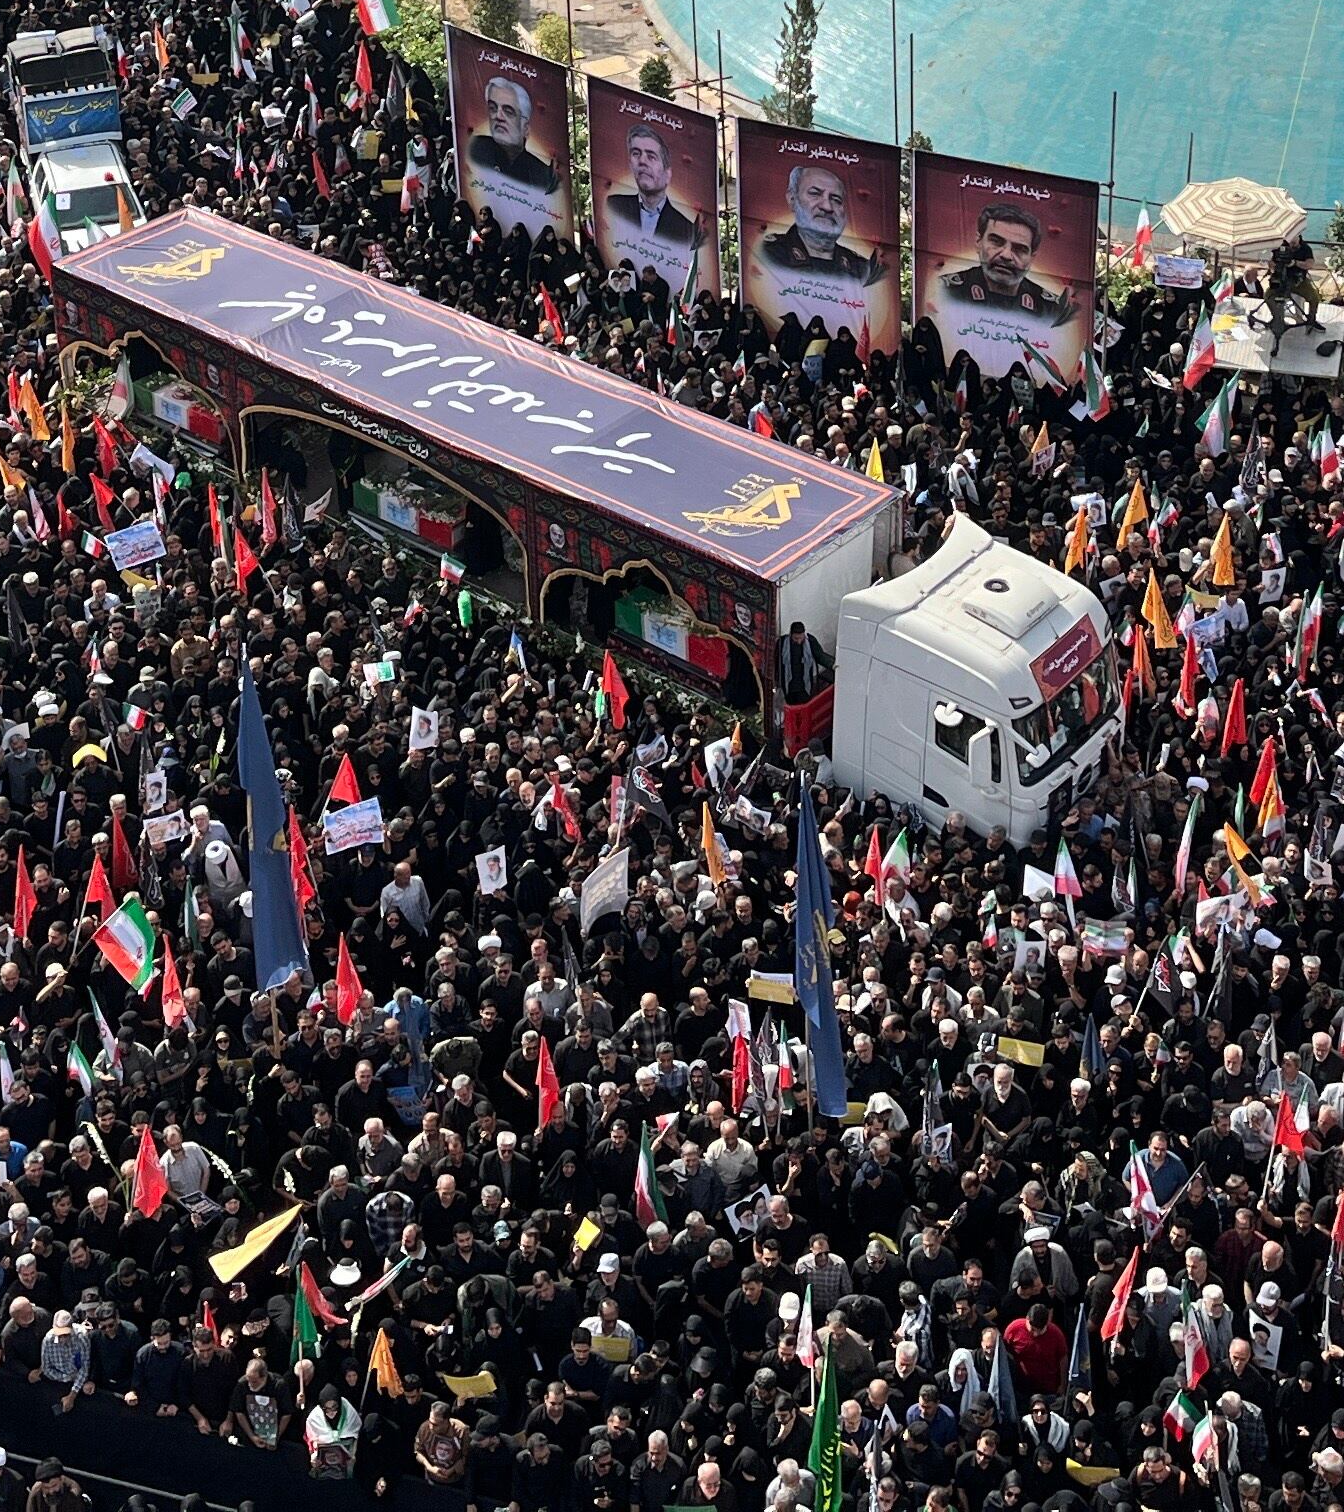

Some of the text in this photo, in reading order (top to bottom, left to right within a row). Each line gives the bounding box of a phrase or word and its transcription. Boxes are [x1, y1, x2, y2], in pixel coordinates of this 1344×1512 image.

[478, 50, 537, 79] شهدا مظهر اقتدار
[619, 100, 683, 131] شهدا مظهر اقتدار
[779, 140, 859, 165] شهدا مظهر اقتدار
[959, 174, 1050, 201] شهدا مظهر اقتدار
[778, 286, 865, 308] شهید محمد کاظمی
[218, 284, 326, 324] سپاه
[550, 432, 676, 475] است
